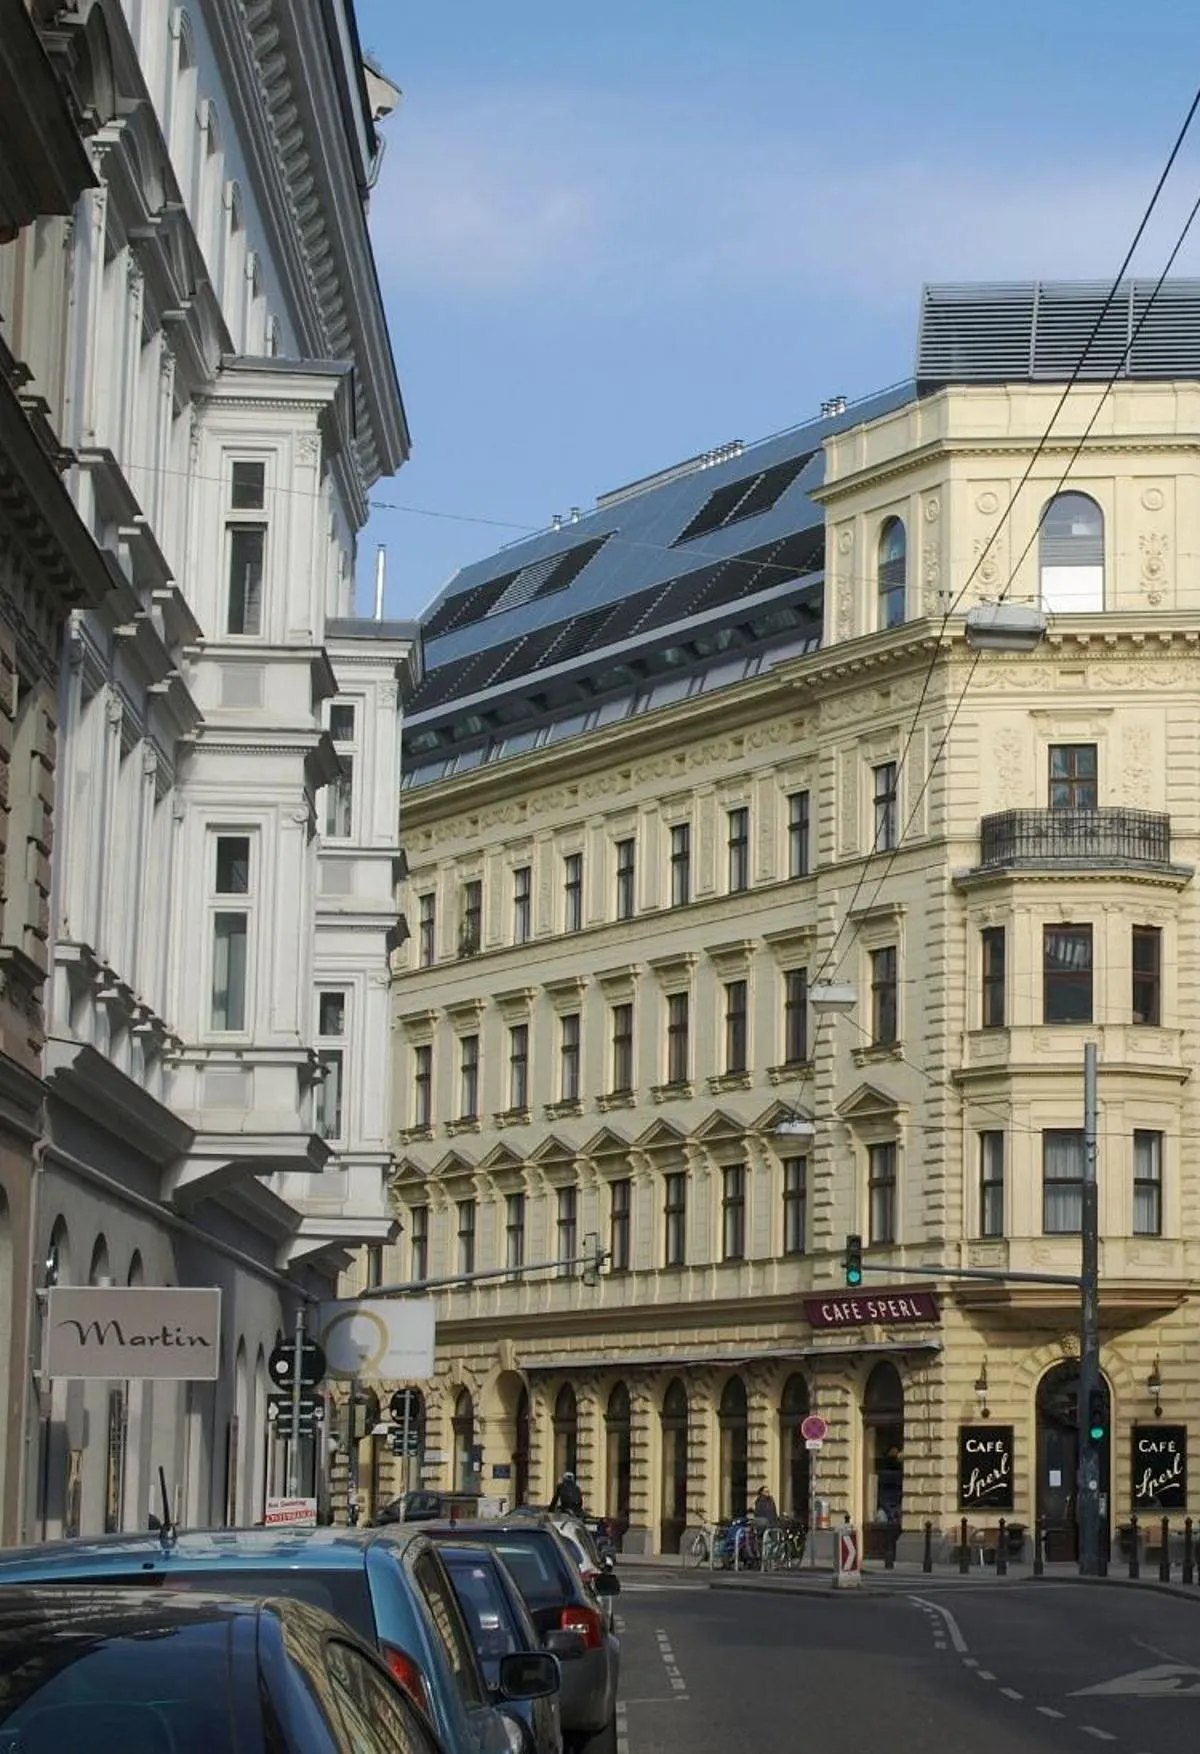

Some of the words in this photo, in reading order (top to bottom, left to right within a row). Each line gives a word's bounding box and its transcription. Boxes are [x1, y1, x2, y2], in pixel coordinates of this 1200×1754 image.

[867, 1298, 922, 1319] SPERL
[54, 1319, 212, 1347] Martin
[962, 1452, 1010, 1498] Sperl
[1134, 1452, 1184, 1498] Sperl
